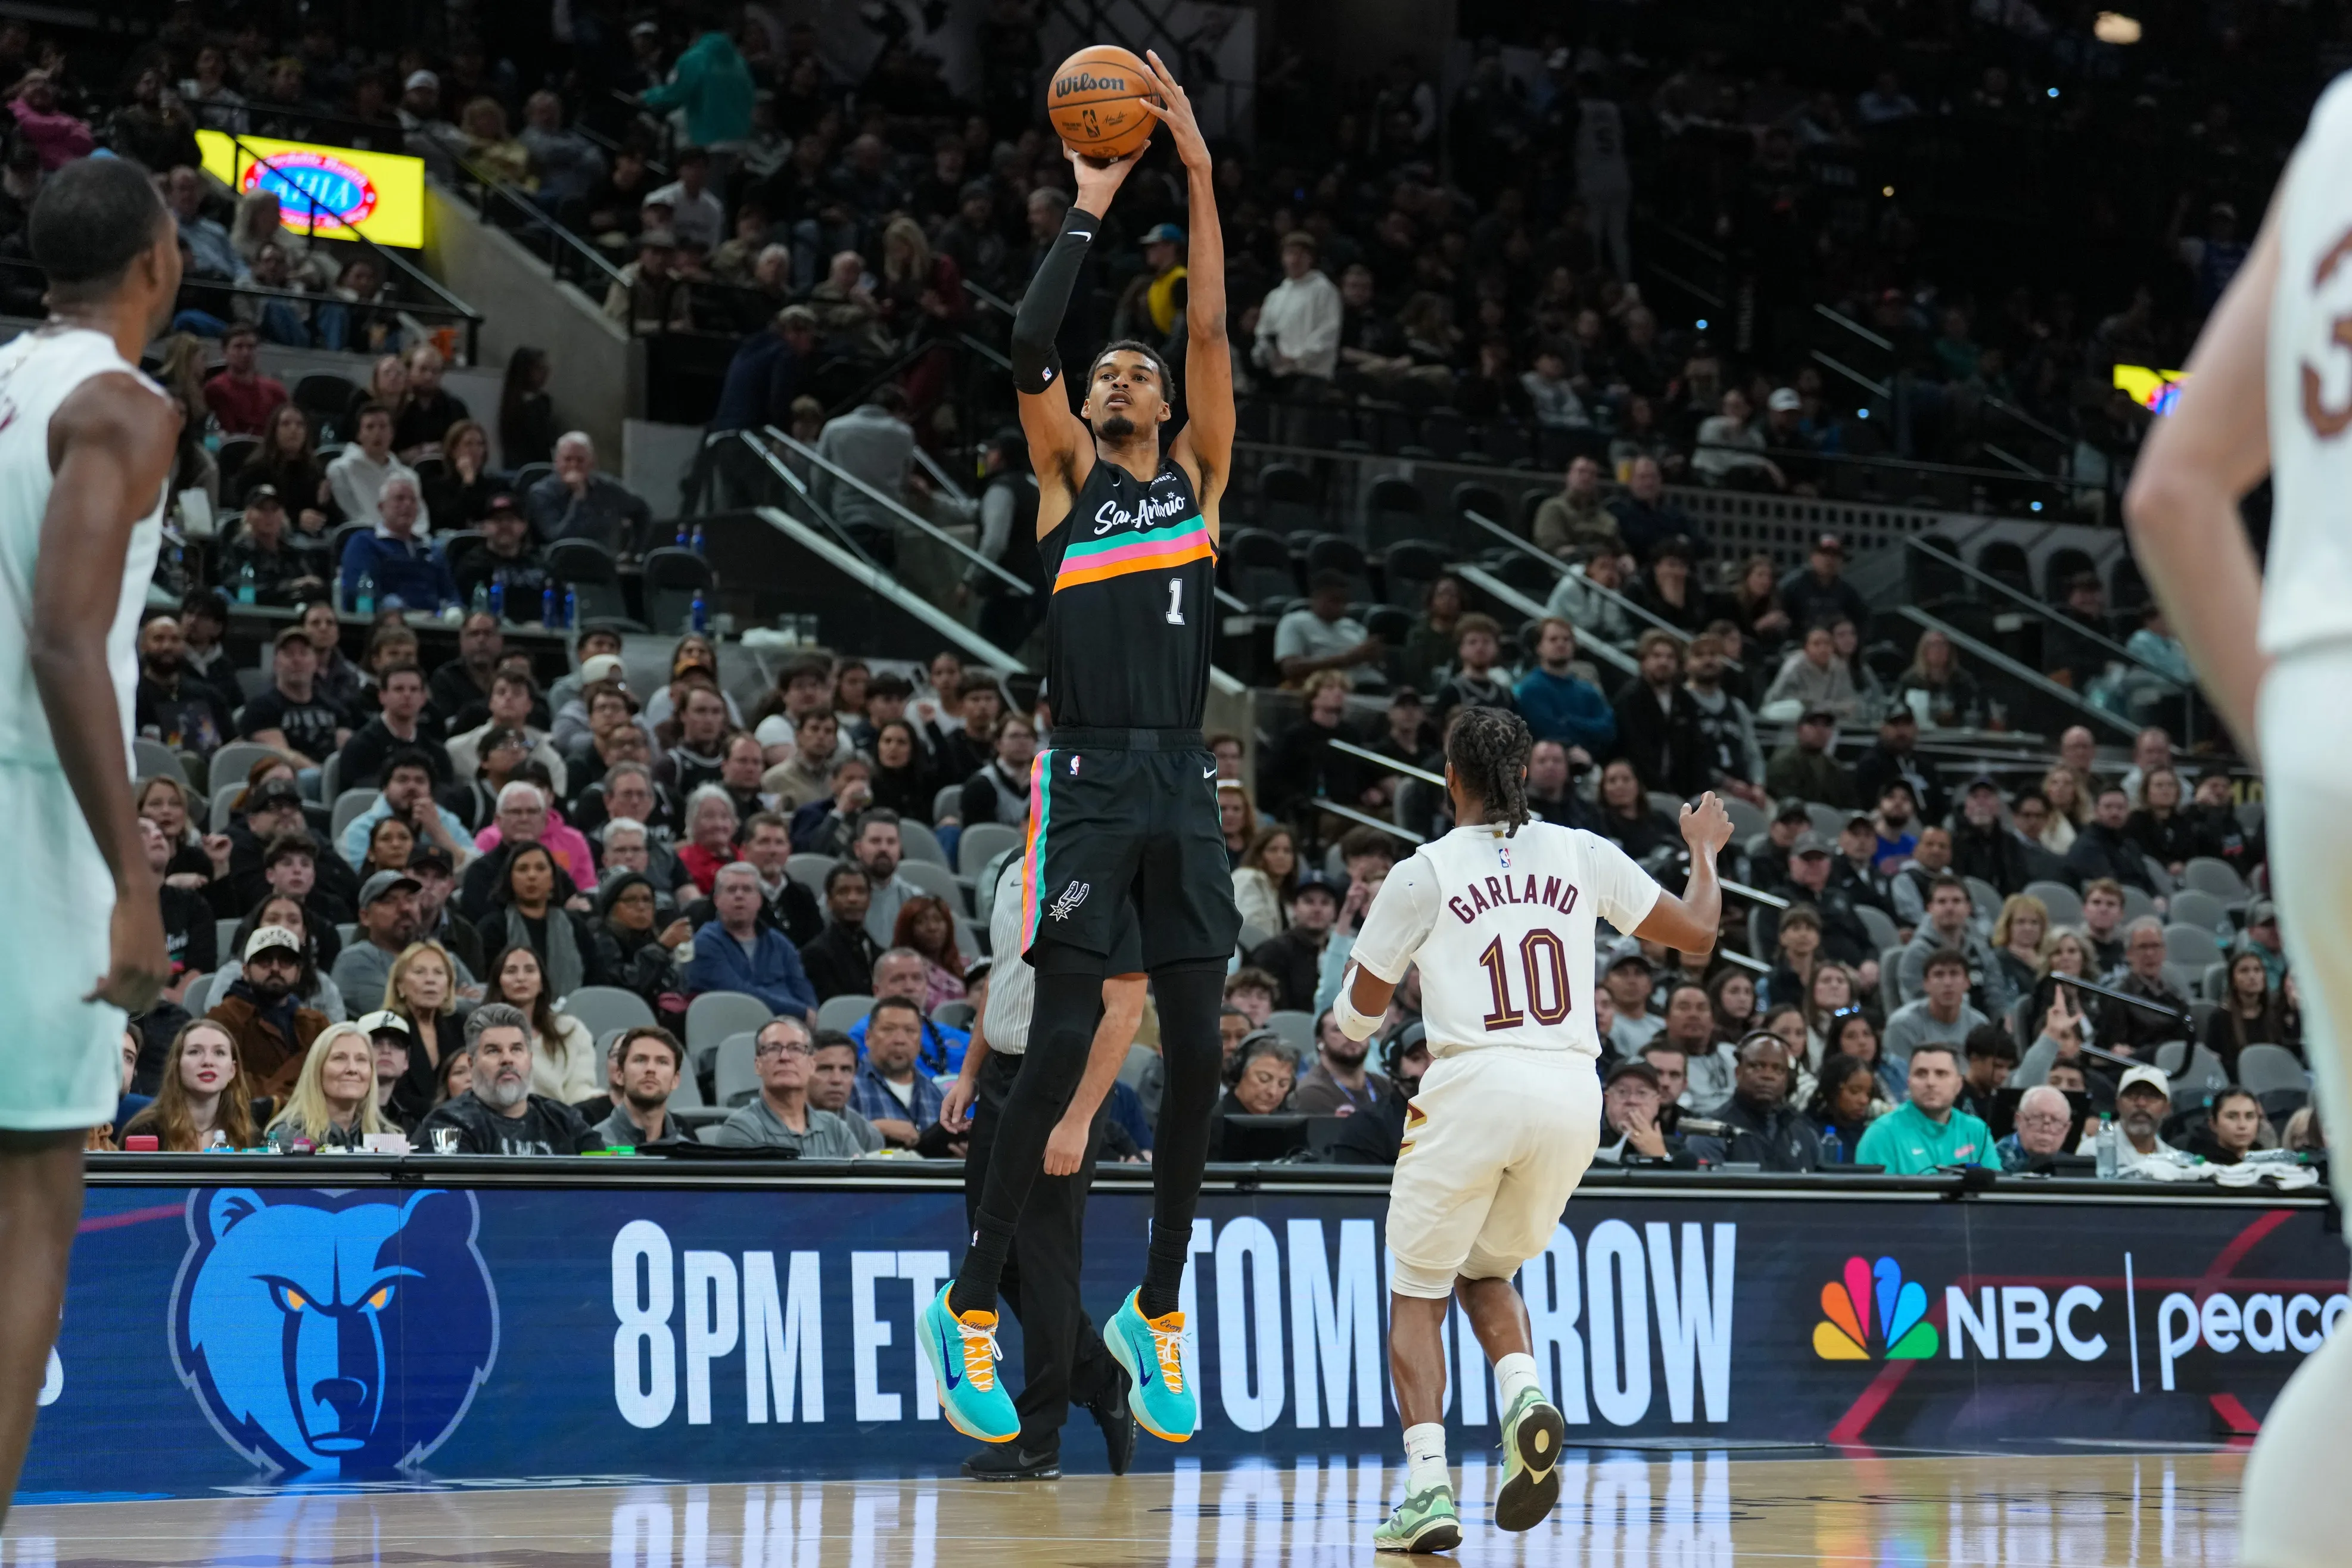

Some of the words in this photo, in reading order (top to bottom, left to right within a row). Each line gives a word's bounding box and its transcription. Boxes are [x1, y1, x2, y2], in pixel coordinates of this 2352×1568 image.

[1056, 73, 1125, 98] Wilson
[1166, 578, 1185, 625] 1
[1449, 875, 1578, 923] GARLAND
[1479, 928, 1572, 1031] 10
[612, 1219, 825, 1429] 8PM
[851, 1250, 950, 1422] ET
[1148, 1216, 1736, 1433] TOMROW
[1946, 1285, 2108, 1361] NBC
[1417, 1499, 1427, 1508] TEN
